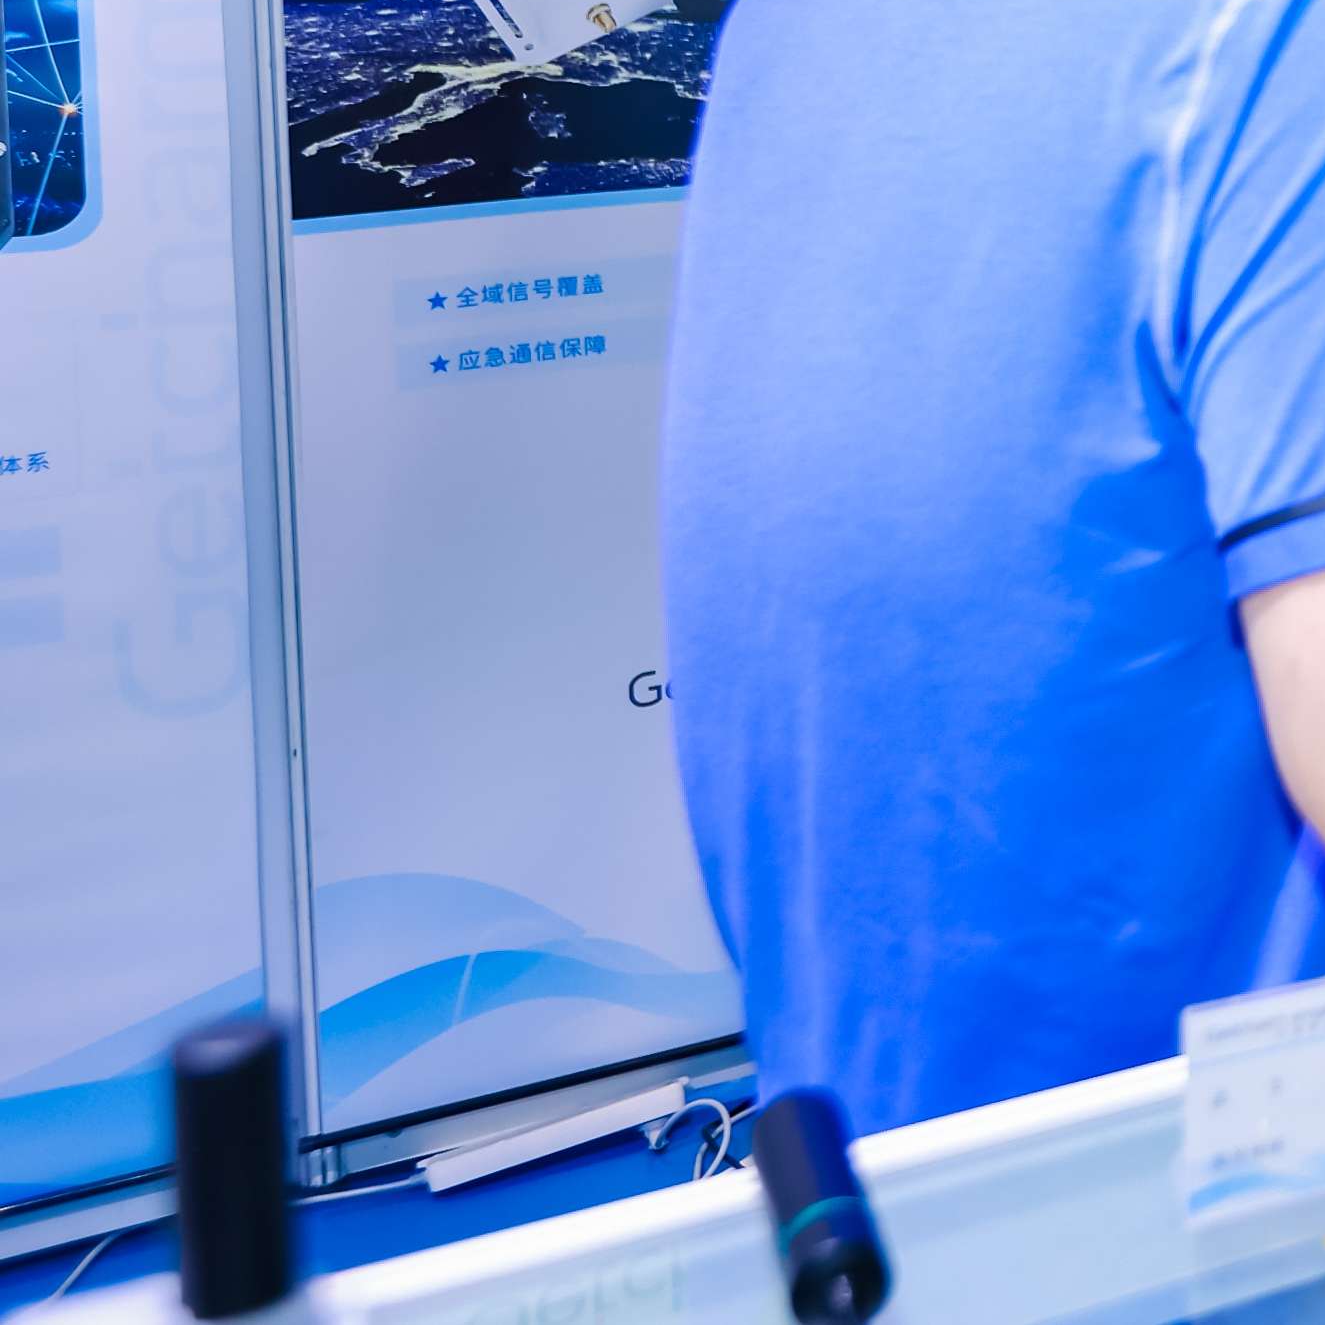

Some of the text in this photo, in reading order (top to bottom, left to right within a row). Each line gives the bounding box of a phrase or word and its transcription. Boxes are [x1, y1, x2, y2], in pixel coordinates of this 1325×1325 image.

[456, 273, 605, 309] 全域信号覆盖
[457, 334, 607, 372] 应急通信保障
